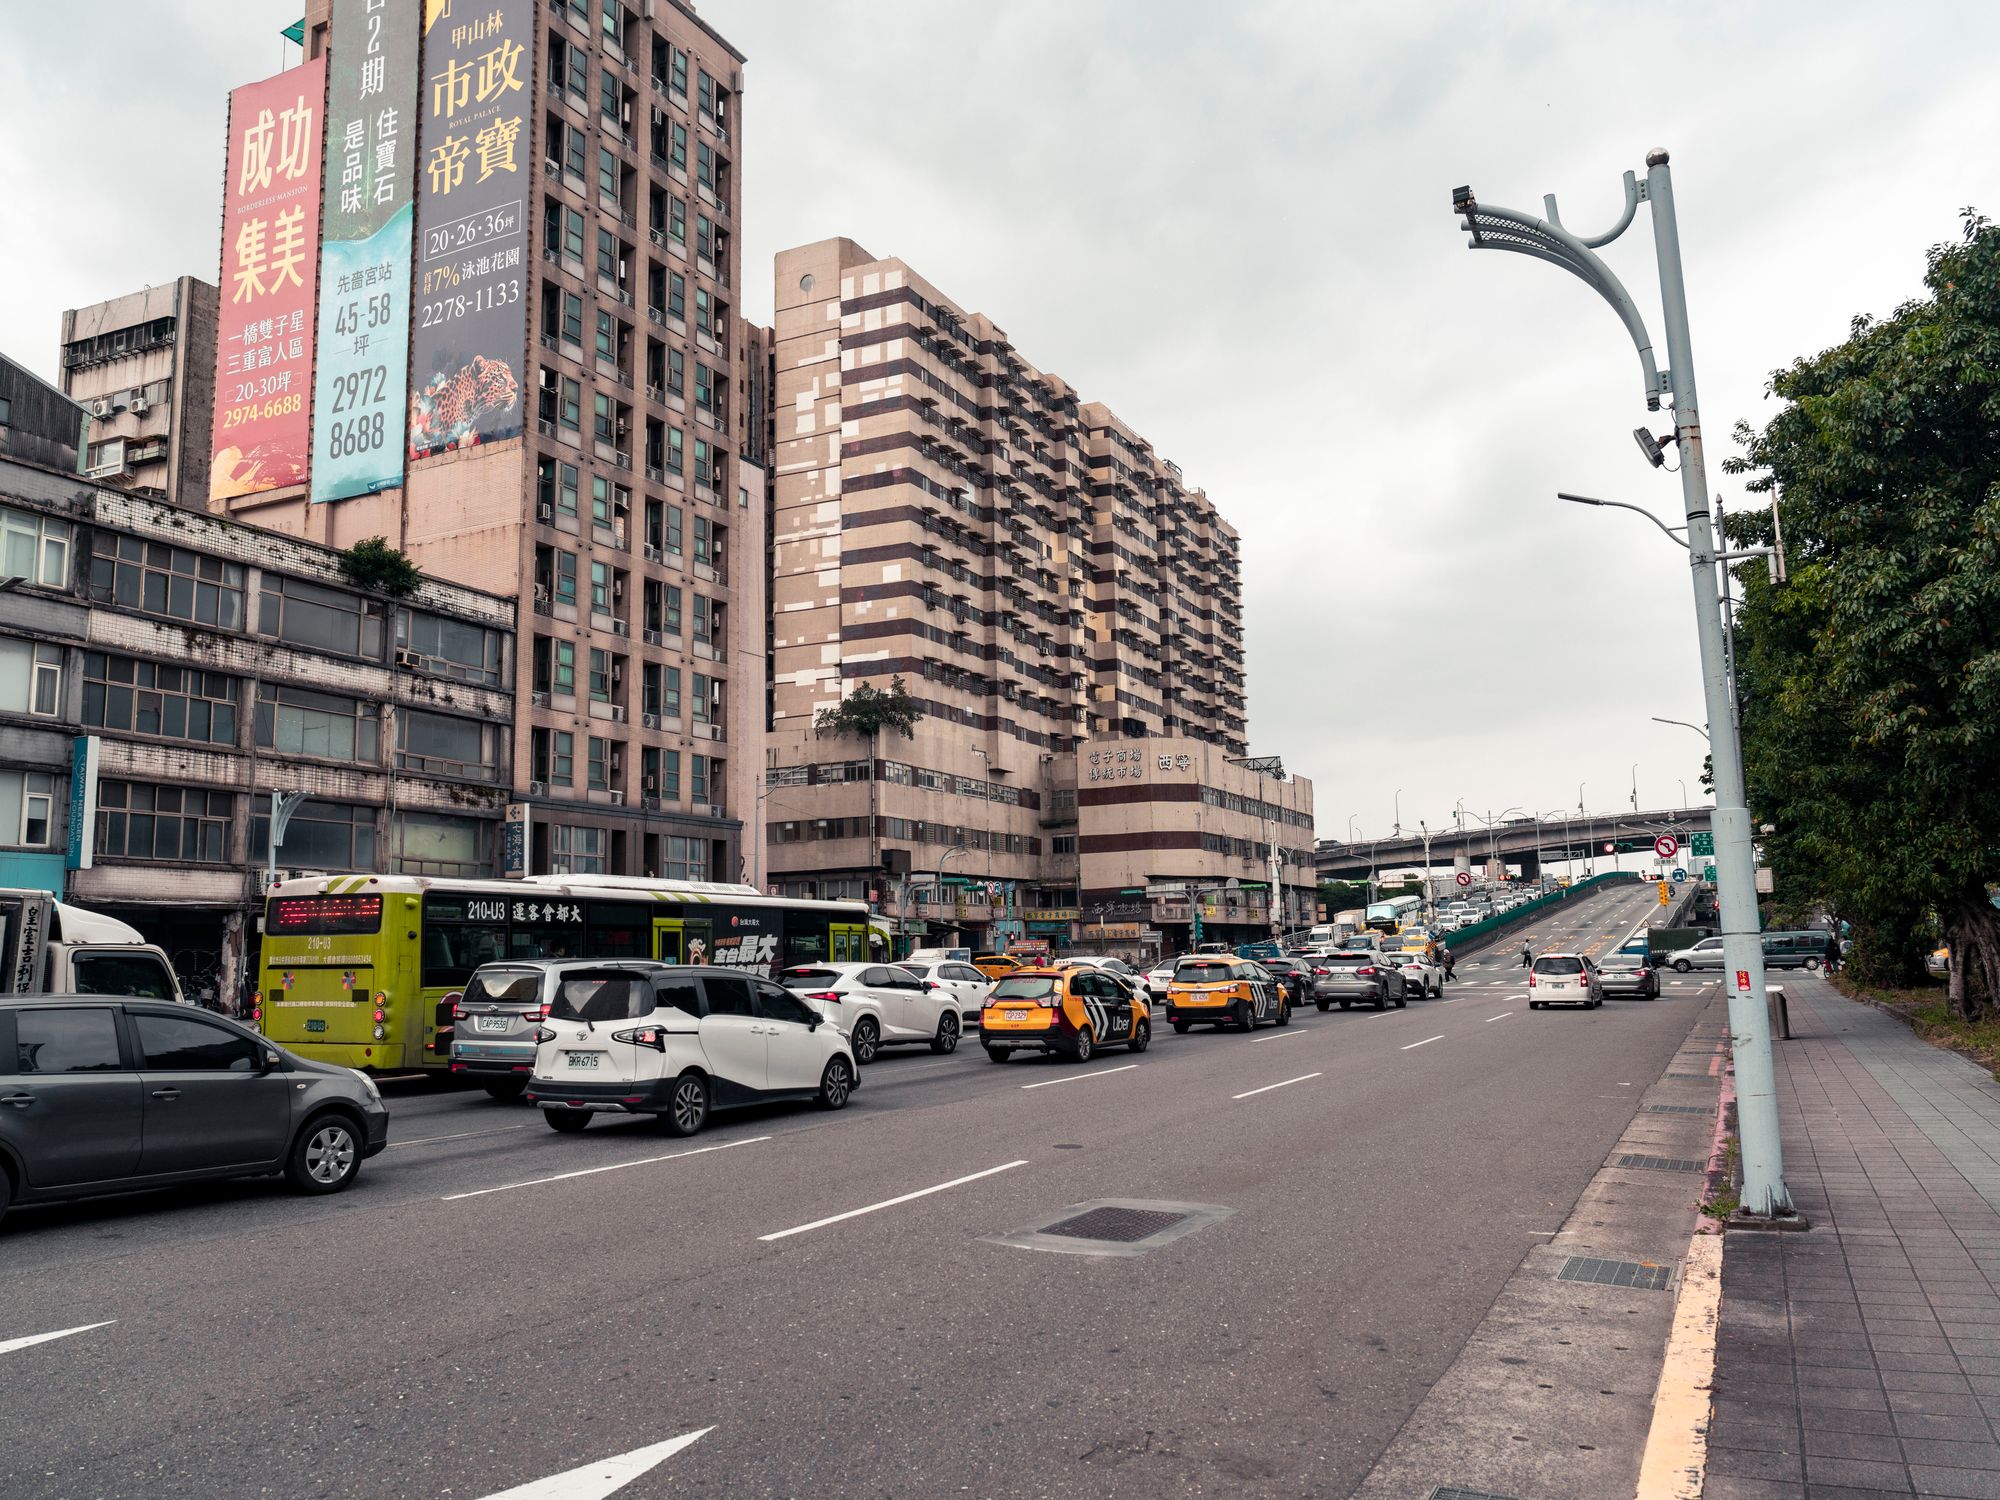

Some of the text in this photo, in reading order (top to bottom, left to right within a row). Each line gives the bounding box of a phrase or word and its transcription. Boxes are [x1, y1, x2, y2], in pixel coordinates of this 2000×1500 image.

[451, 9, 504, 49] 甲山林
[431, 39, 525, 118] 市政
[449, 105, 501, 129] ROYAL PALACE
[238, 95, 313, 197] 成功
[373, 107, 399, 205] 住寶石
[427, 116, 522, 195] 帝寶
[341, 119, 364, 214] 是品味
[237, 184, 308, 214] BORDERLESS MANSION
[232, 205, 306, 304] 集美
[434, 264, 460, 291] 7%
[462, 247, 520, 281] 泳池花園
[337, 261, 392, 296] 先嗇宮站
[335, 293, 391, 336] 45-58
[421, 280, 519, 328] 2278-1133
[228, 309, 304, 347] 一橋雙子星
[353, 335, 369, 357] 坪
[226, 336, 304, 376] 三重富人區
[235, 371, 292, 403] 20-30坪
[332, 365, 387, 414] 2972
[223, 394, 301, 429] 2974-6688
[330, 412, 384, 460] 8688
[1089, 748, 1142, 764] 電子商場
[1089, 765, 1142, 781] 傳統市場
[1158, 753, 1191, 771] 西寧
[76, 762, 86, 842] TAIWAN NEXTGEN
[69, 800, 77, 857] FOUNDATION
[468, 901, 505, 920] 210-U3
[308, 937, 331, 950] 210-U3
[1269, 997, 1278, 1009] Uber
[1112, 1016, 1130, 1032] Uber
